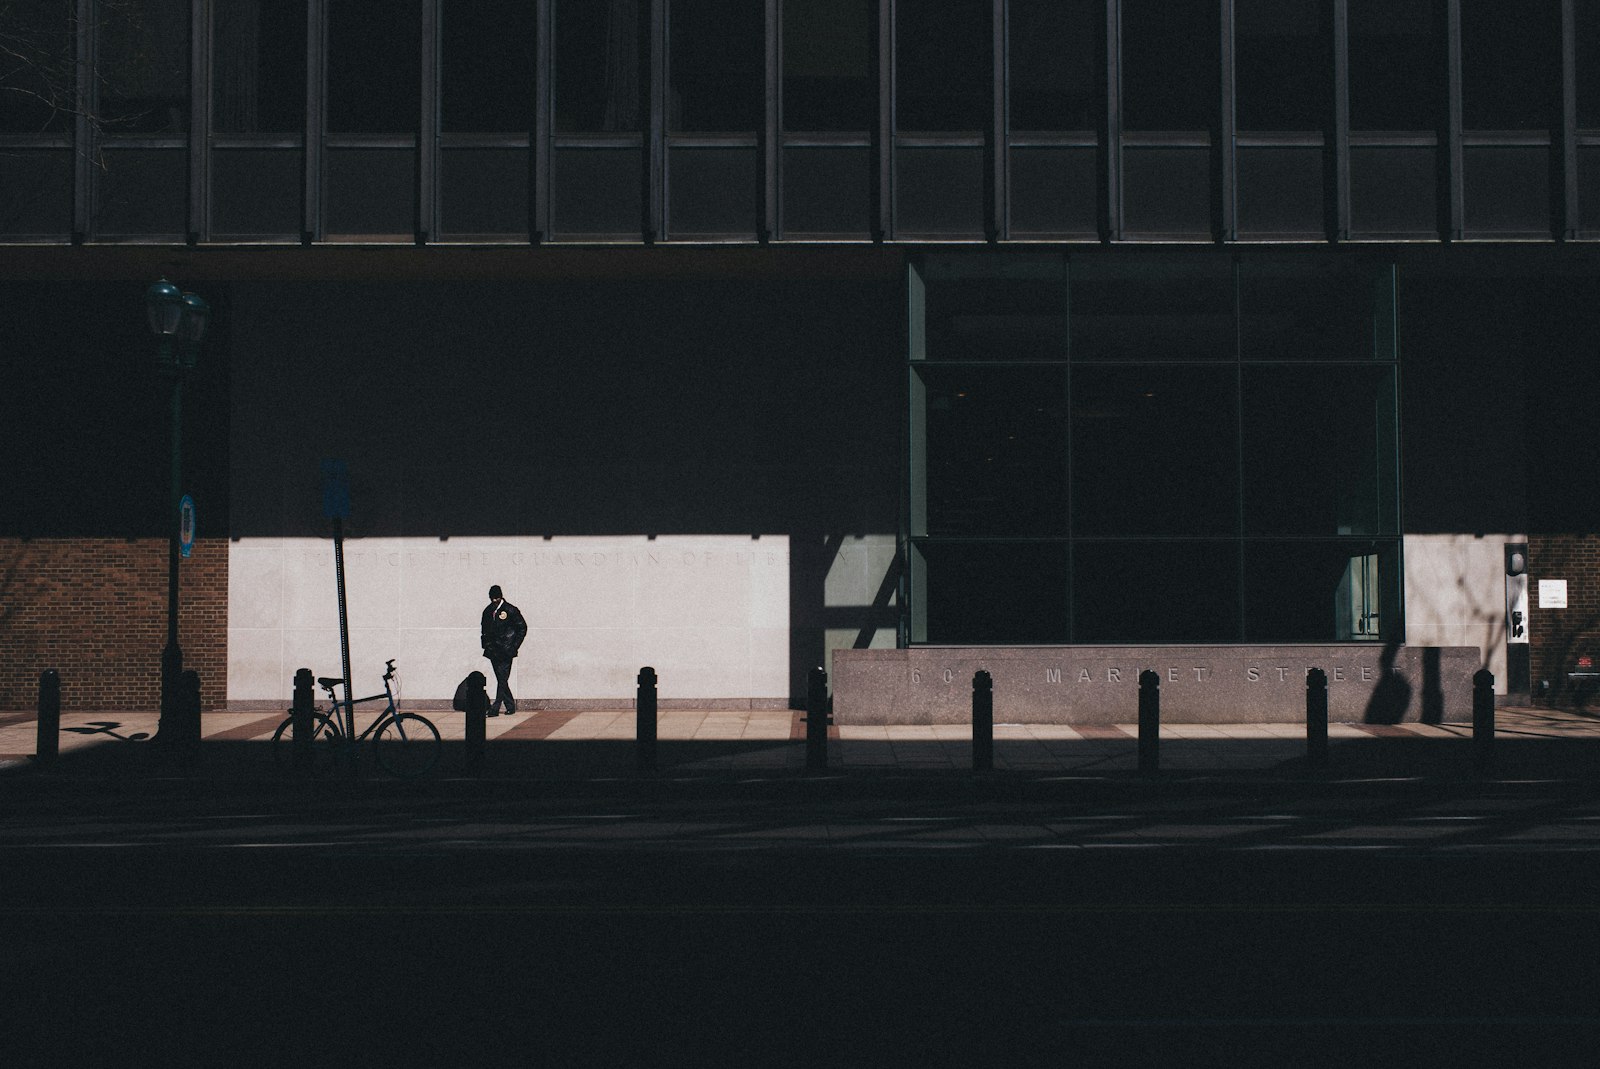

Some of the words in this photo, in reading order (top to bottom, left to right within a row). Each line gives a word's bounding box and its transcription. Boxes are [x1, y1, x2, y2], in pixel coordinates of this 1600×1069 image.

[436, 551, 489, 567] THE
[511, 551, 661, 567] GUARDIAN
[683, 551, 713, 567] OF
[1046, 667, 1207, 684] MARET
